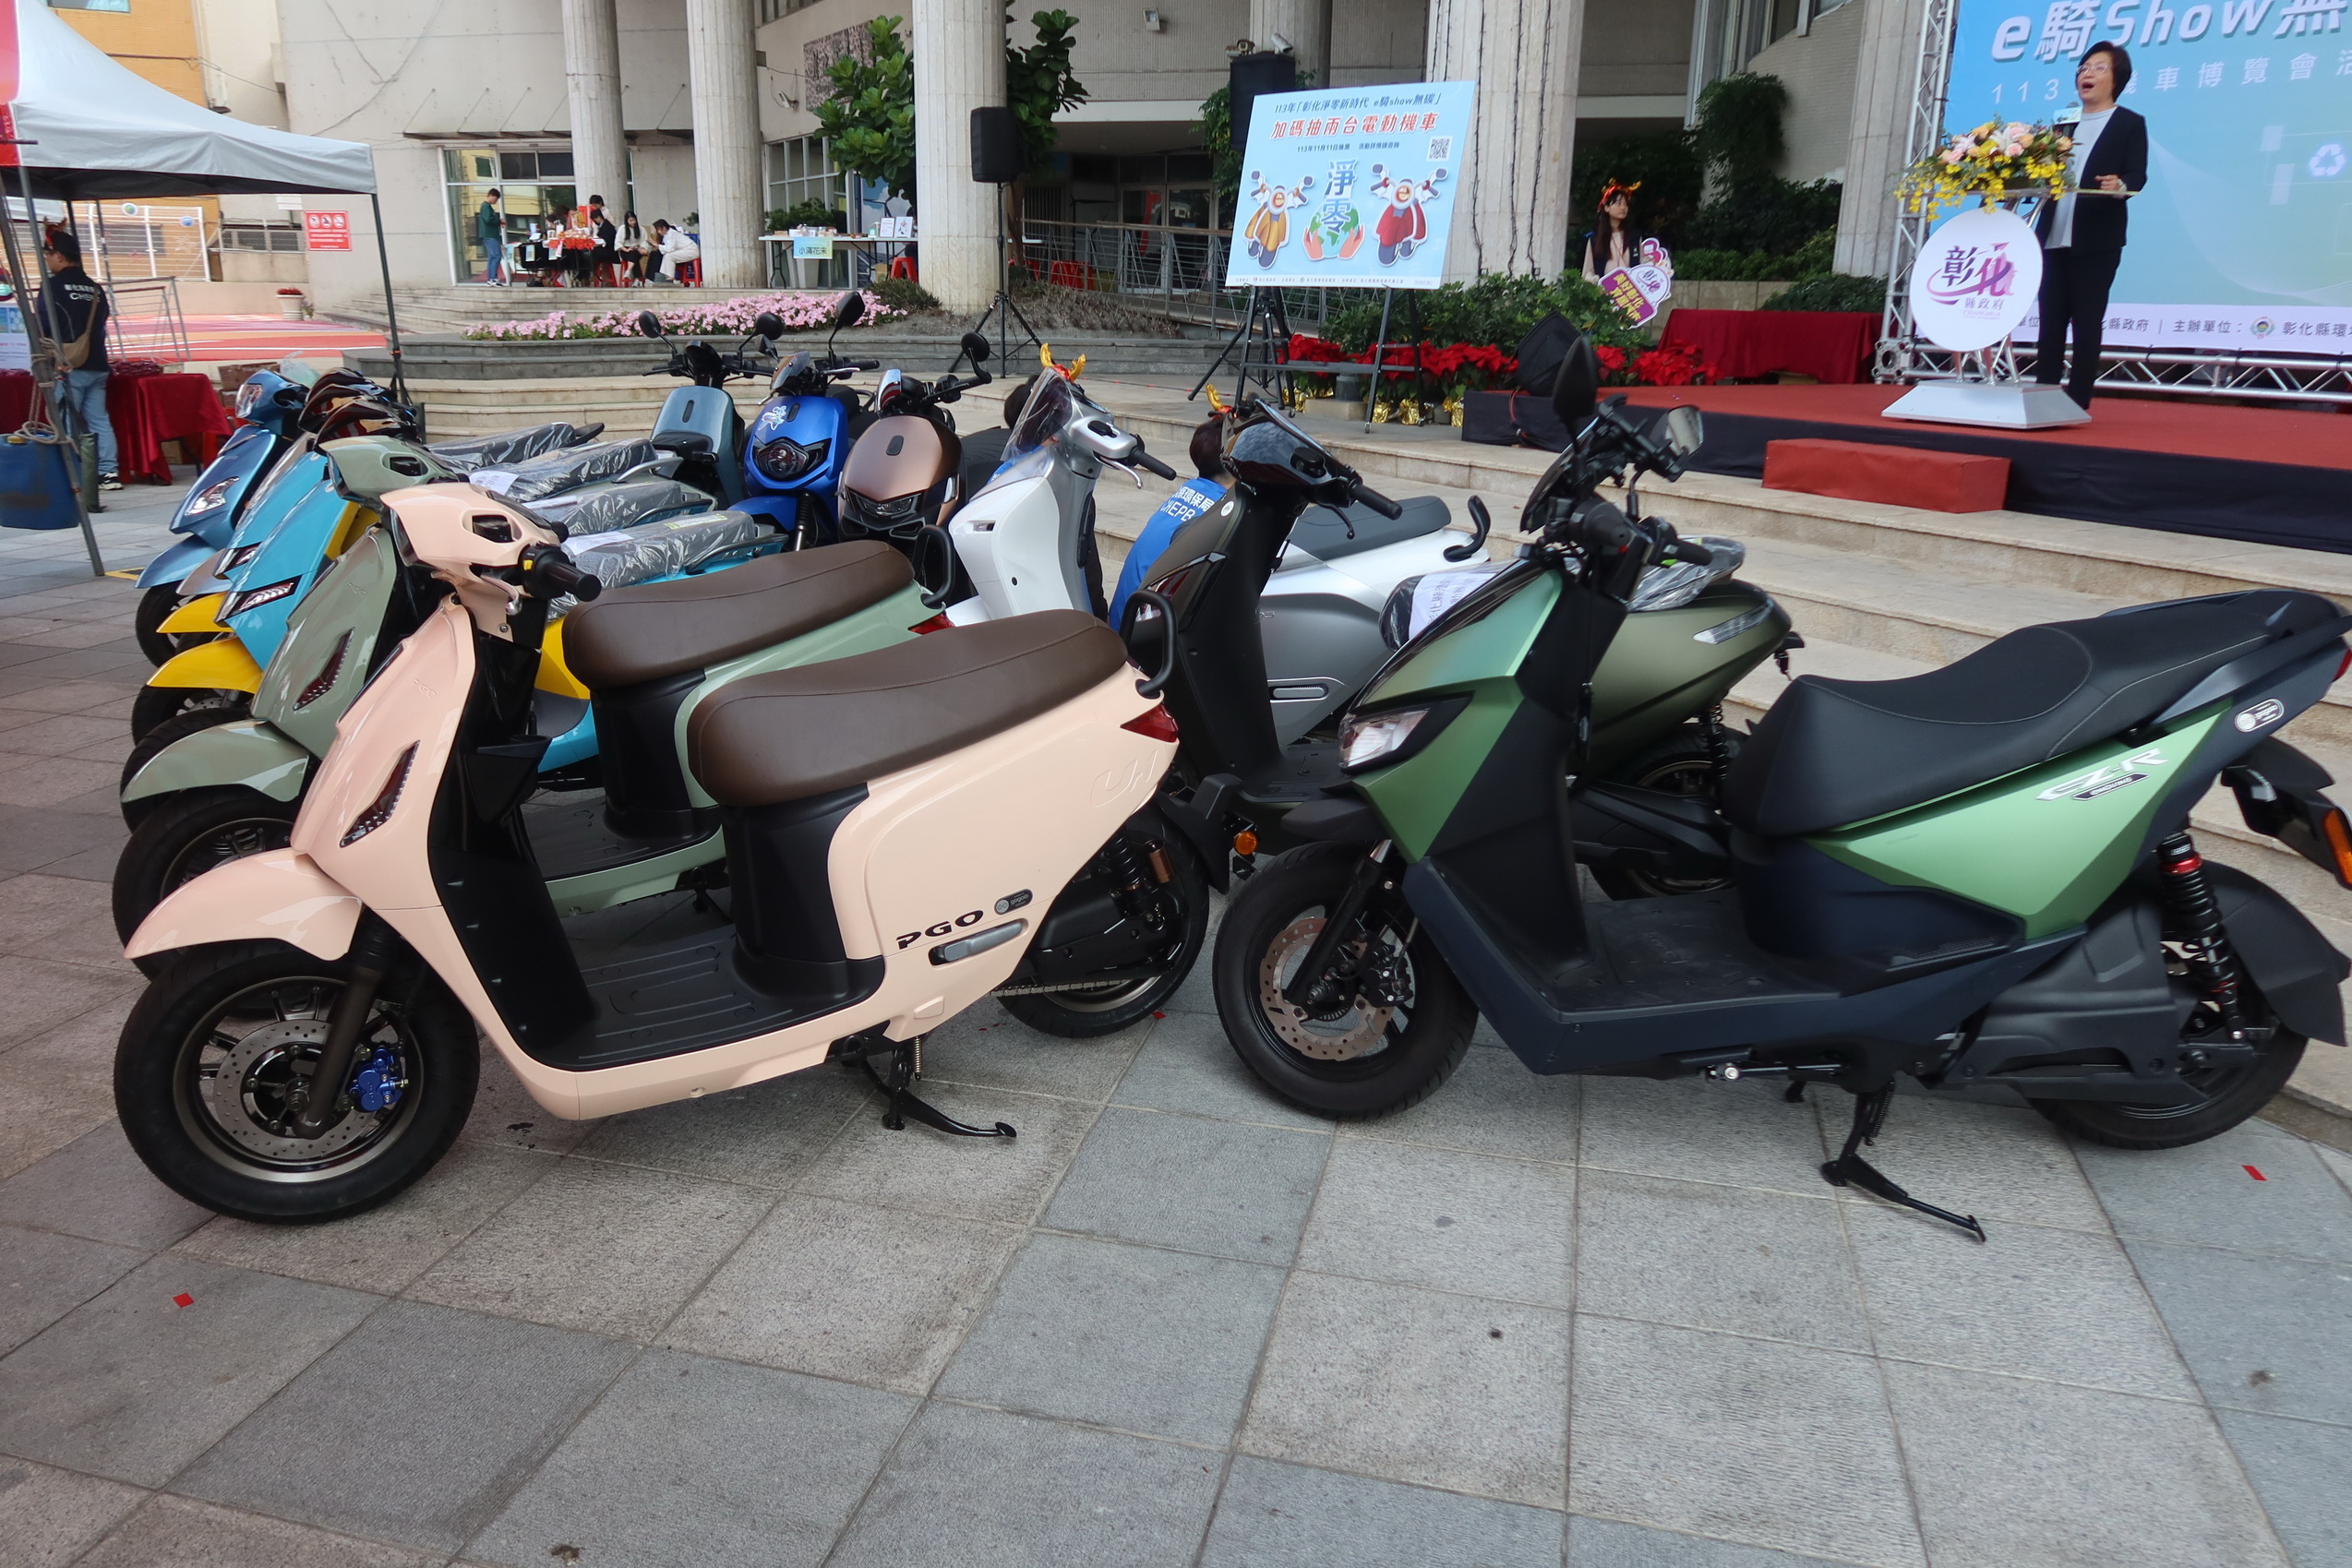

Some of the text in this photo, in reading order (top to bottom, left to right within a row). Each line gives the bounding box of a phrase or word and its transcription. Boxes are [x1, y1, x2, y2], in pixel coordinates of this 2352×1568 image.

[1271, 112, 1439, 139] 加碼抽兩台電動機車
[1321, 160, 1358, 233] 淨零
[1941, 242, 2013, 297] 彰化
[1964, 297, 2004, 310] 縣政府
[2283, 321, 2352, 338] 彰化縣環
[1010, 893, 1029, 906] gogoro
[894, 909, 984, 951] PGO
